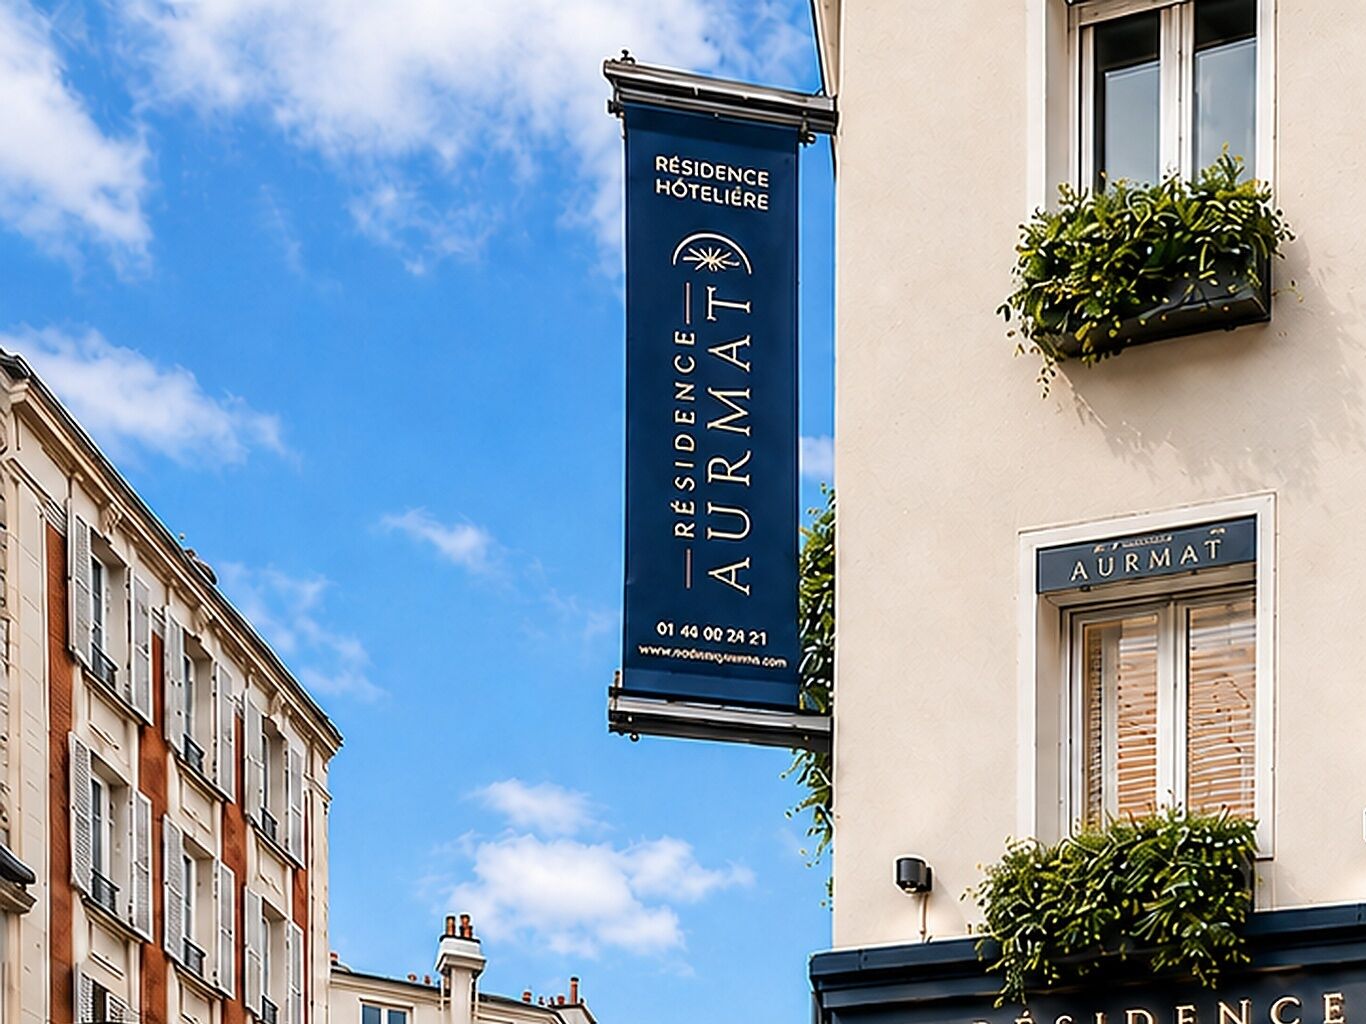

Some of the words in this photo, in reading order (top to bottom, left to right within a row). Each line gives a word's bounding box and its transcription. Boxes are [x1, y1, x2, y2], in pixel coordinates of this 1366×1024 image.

[656, 156, 769, 187] RÉSIDENCE
[671, 331, 695, 538] RÉSIDENCE
[707, 286, 751, 596] AURMAT
[1070, 540, 1222, 581] AURMAT
[656, 621, 674, 637] 01
[748, 630, 767, 646] 21
